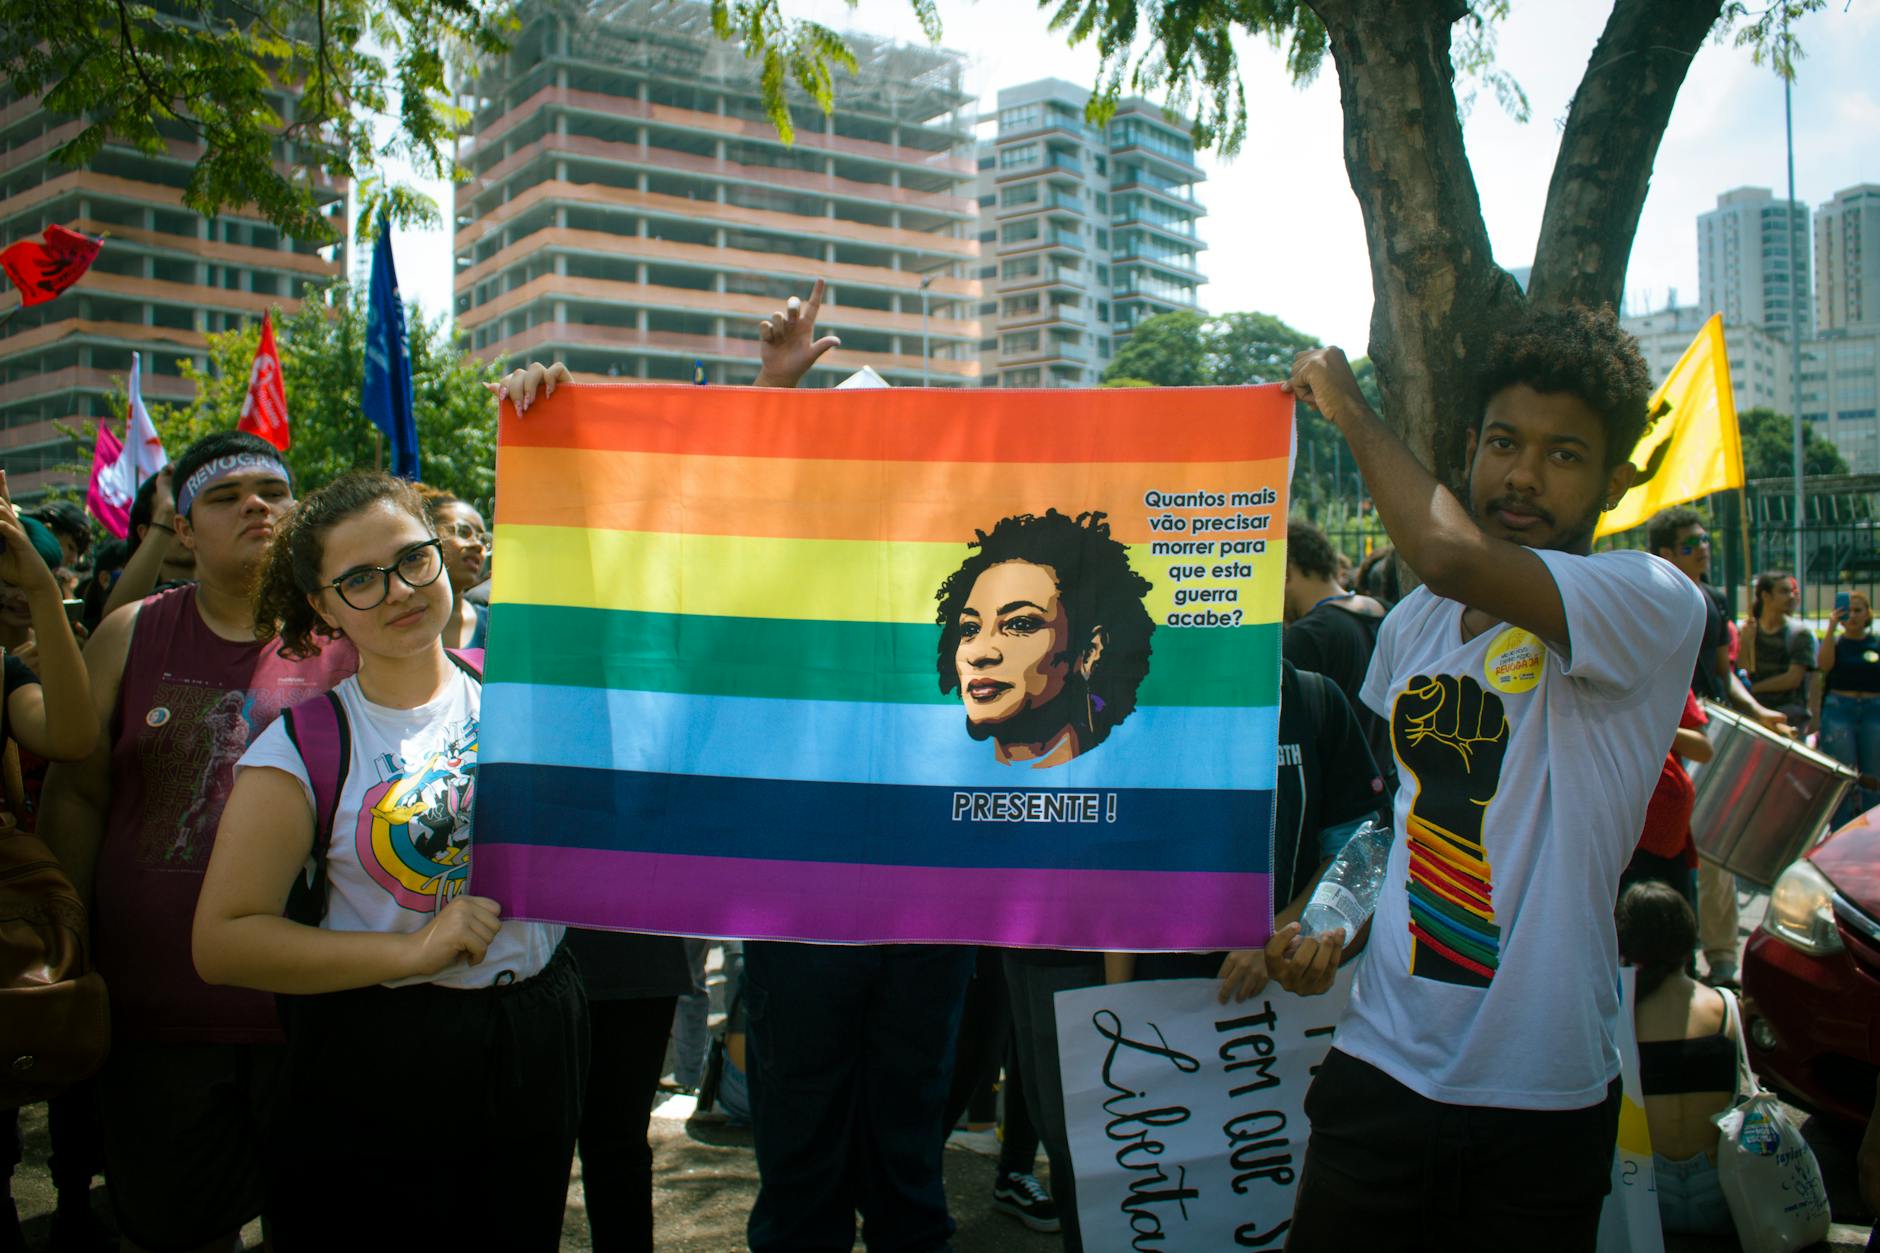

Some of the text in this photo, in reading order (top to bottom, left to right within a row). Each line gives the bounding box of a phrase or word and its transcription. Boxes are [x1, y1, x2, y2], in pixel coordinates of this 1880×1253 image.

[1144, 488, 1276, 508] Quantos mais
[1149, 513, 1271, 535] vão precisar
[1152, 540, 1266, 558] morrer para
[1168, 562, 1252, 582] que esta
[1174, 589, 1239, 606] guerra
[1167, 609, 1243, 626] acabe?
[952, 792, 1099, 823] PRESENTE
[1093, 1010, 1200, 1253] Liberta
